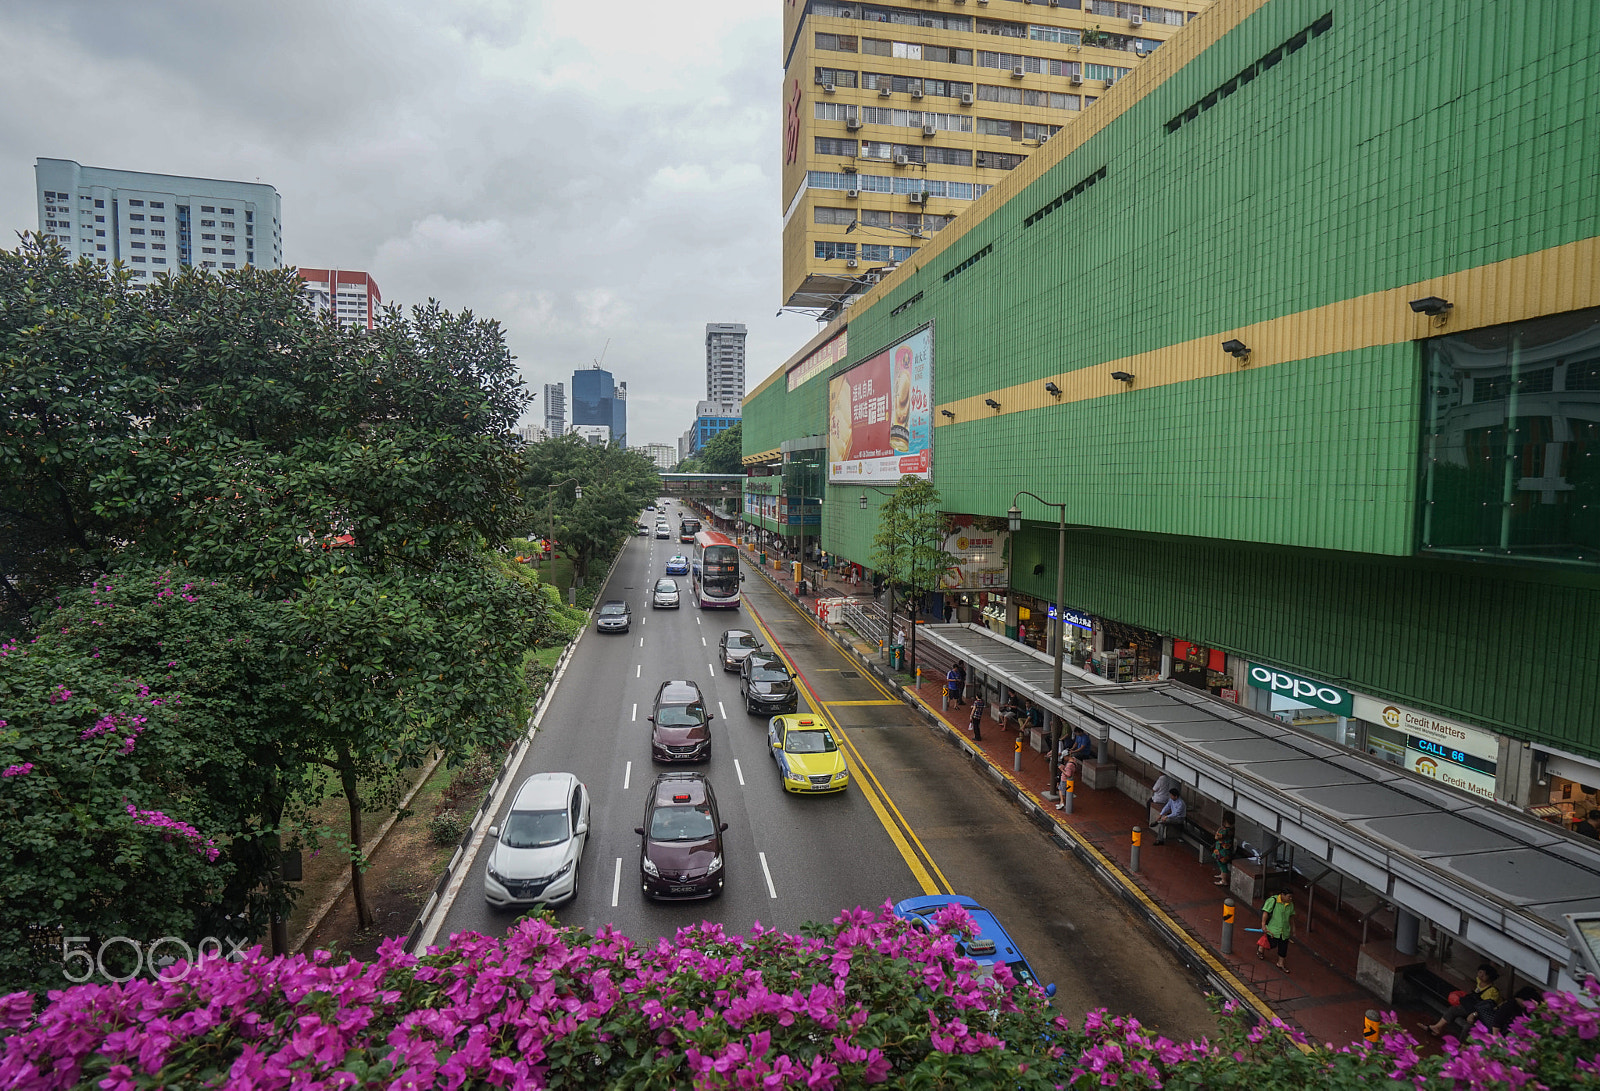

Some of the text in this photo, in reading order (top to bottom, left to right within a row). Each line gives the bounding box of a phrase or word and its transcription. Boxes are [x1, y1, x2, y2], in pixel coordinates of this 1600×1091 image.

[1405, 713, 1431, 729] Credit
[1431, 721, 1466, 740] Matters
[1418, 740, 1465, 762] CALL 66
[1442, 773, 1467, 789] Credit
